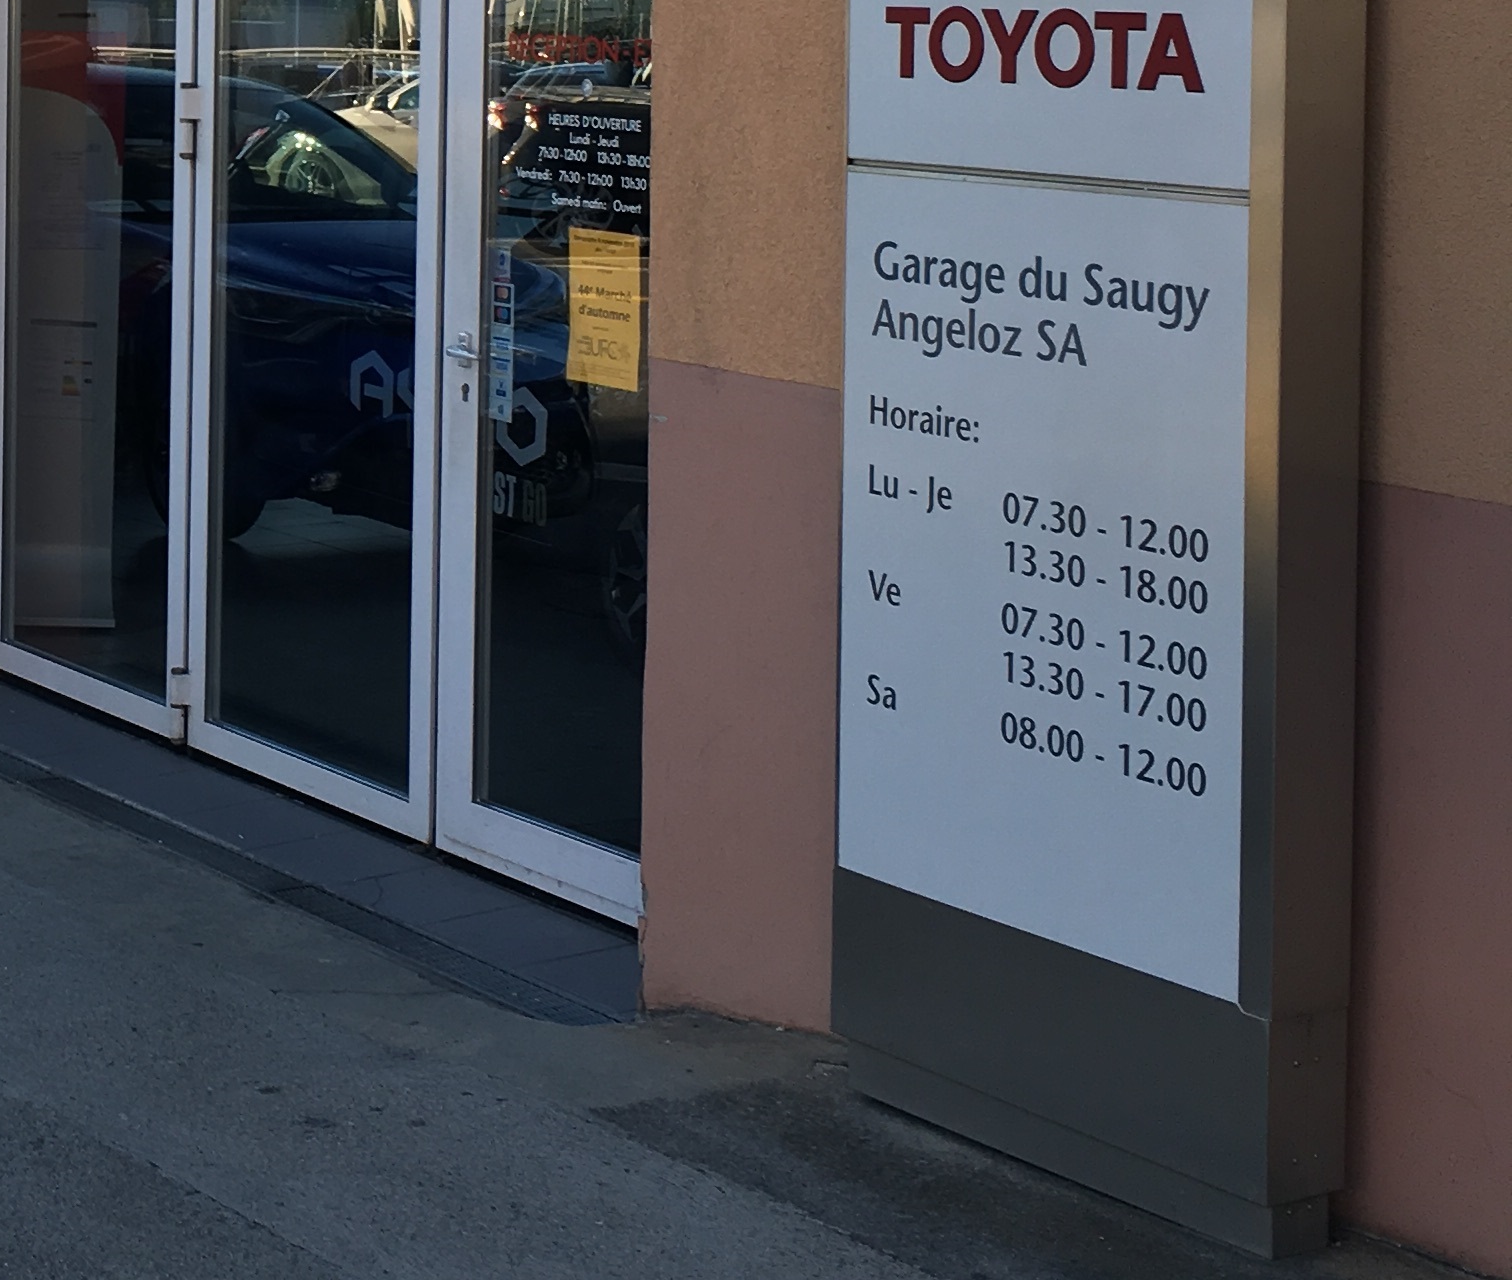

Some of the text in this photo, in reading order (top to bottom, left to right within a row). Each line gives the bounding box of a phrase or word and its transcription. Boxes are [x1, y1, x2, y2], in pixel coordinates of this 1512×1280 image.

[885, 5, 1206, 94] TOYOTA
[548, 113, 642, 132] HEURES D'OUVERTURE
[569, 132, 591, 145] Lundi
[597, 134, 620, 148] Jeudi
[515, 166, 553, 181] Vendredi:
[620, 175, 647, 191] 13h30
[551, 192, 581, 207] Samedi
[613, 199, 642, 214] Ouvert
[873, 240, 1210, 332] Garage du Saugy
[871, 298, 1088, 367] Angeloz SA
[869, 394, 980, 444] Horaire:
[868, 464, 899, 499] Lu
[908, 488, 918, 496] -
[926, 475, 953, 513] Je
[1002, 492, 1087, 538] 07.30
[1120, 515, 1209, 563] 12.00
[1003, 541, 1086, 587] 13.30
[1119, 565, 1209, 614] 18.00
[868, 569, 902, 607] Ve
[1001, 602, 1085, 651] 07.30
[1119, 630, 1208, 681] 12.00
[1002, 651, 1084, 701] 13.30
[1117, 680, 1208, 732] 17.00
[866, 674, 897, 711] Sa
[1000, 712, 1085, 763] 08.00
[1117, 743, 1208, 798] 12.00
